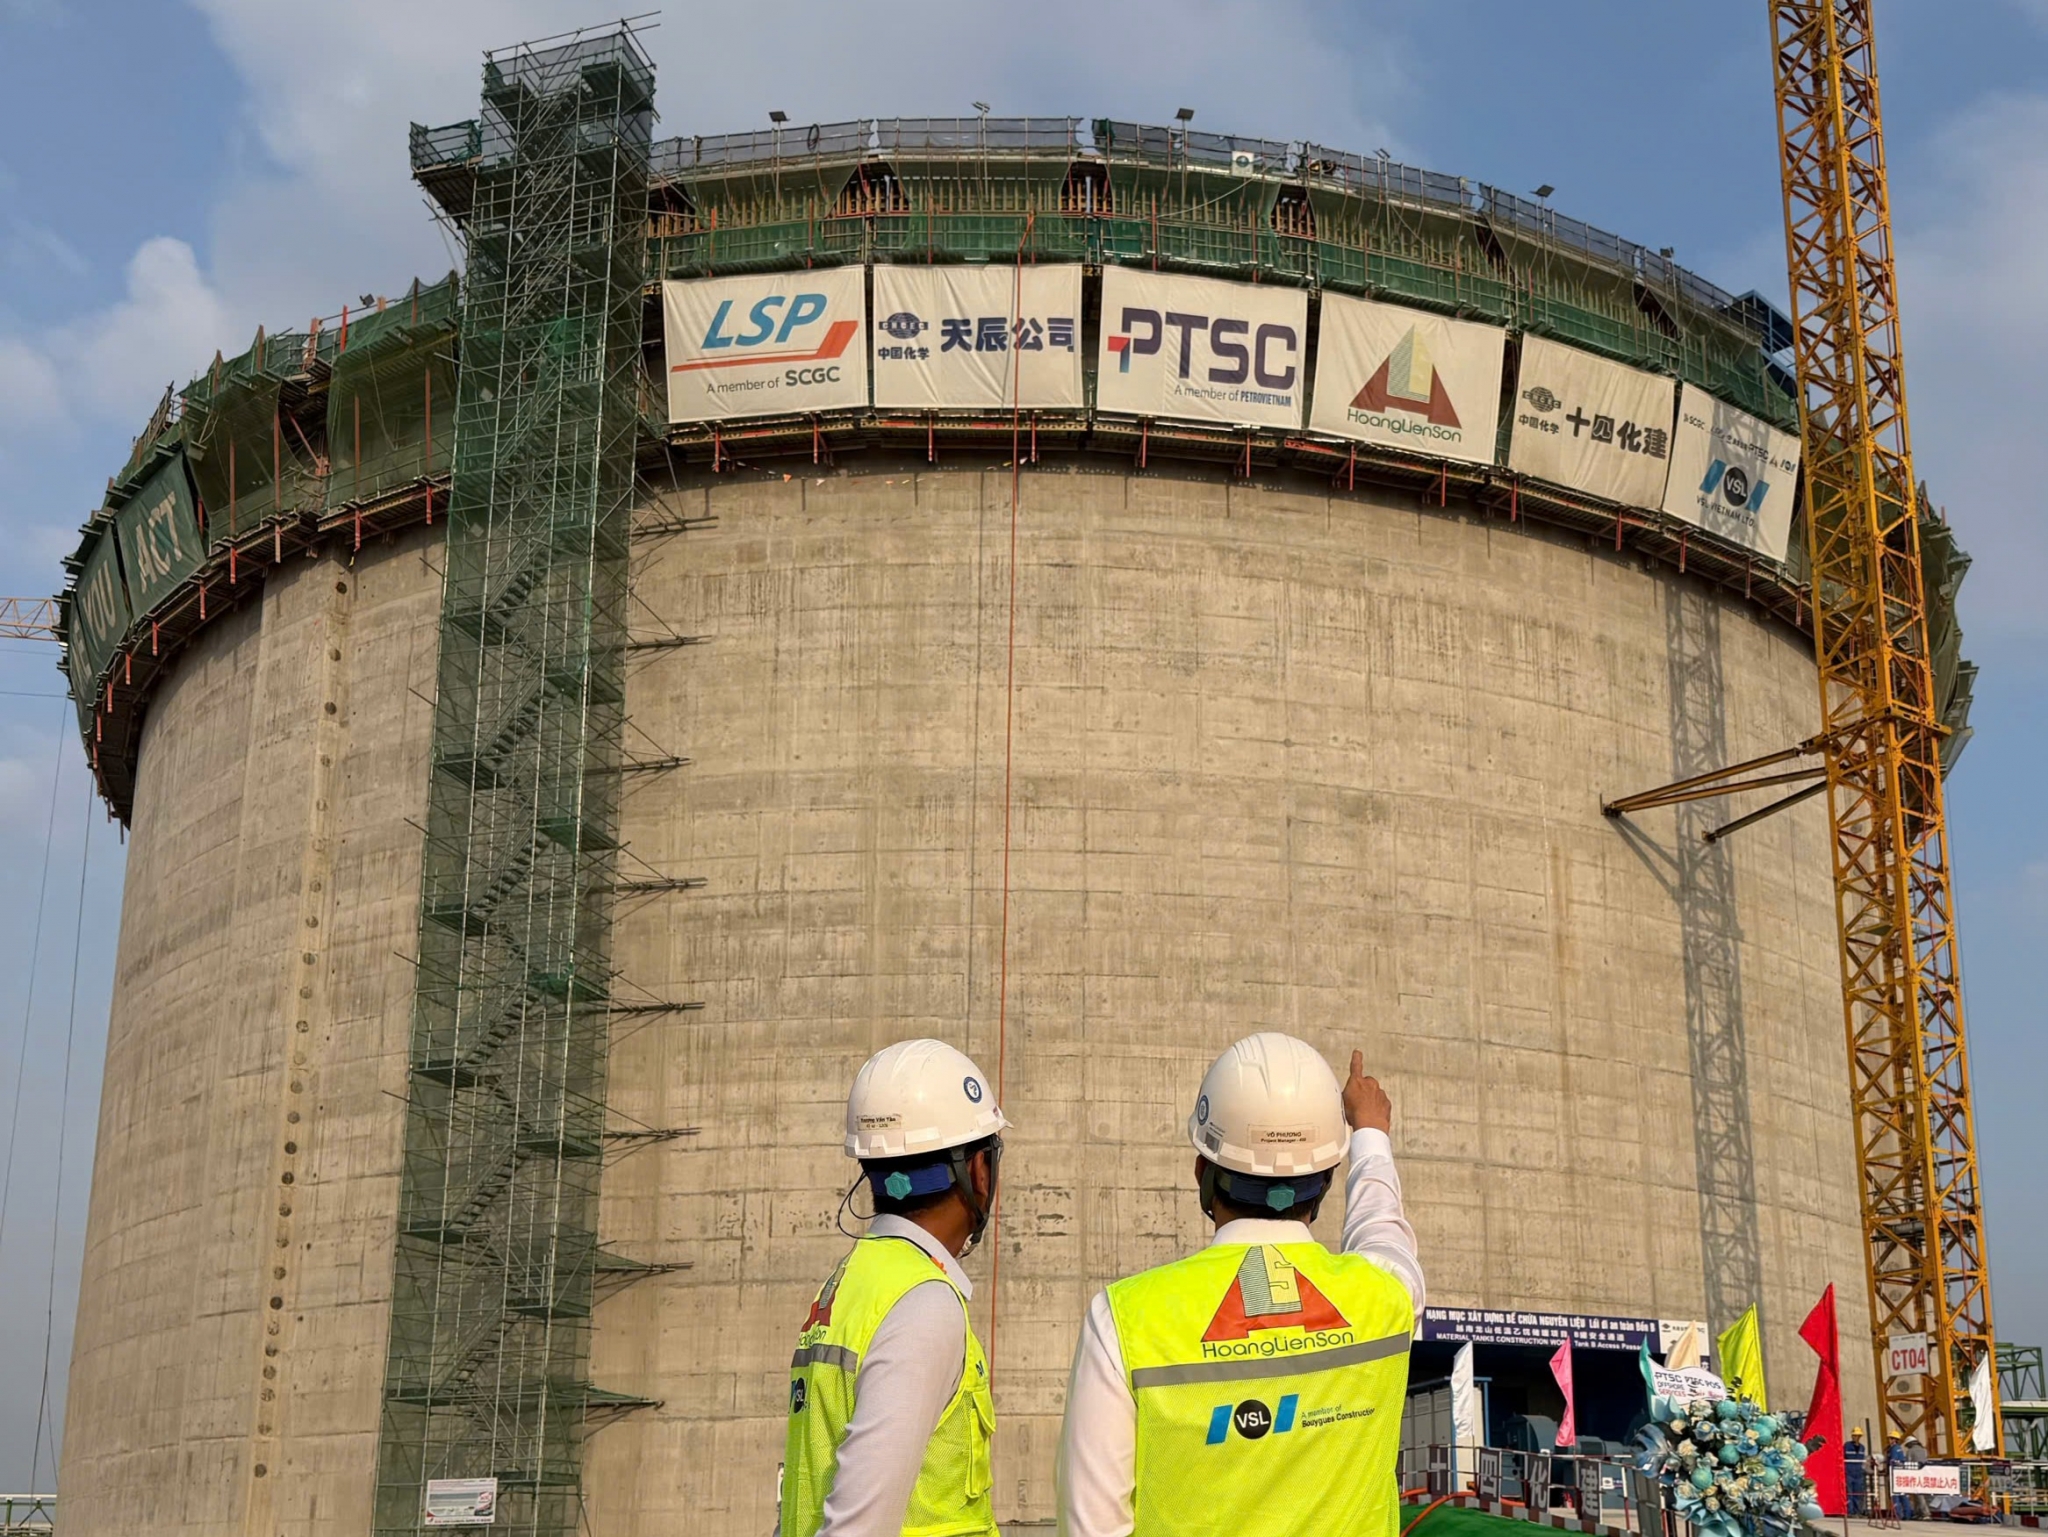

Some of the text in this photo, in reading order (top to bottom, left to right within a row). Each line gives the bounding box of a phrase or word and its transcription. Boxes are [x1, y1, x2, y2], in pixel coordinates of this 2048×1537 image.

[701, 294, 828, 349] LSP
[941, 317, 1074, 353] 天辰公司
[1108, 307, 1297, 390] PTSC
[706, 366, 840, 394] A member of SCGC
[1174, 385, 1291, 407] A member of PETROVIETNAM
[1347, 408, 1462, 442] HoangLienSon
[1565, 406, 1668, 460] 十四化建
[1726, 475, 1747, 497] VSL
[1711, 502, 1741, 521] VIETNAM
[82, 490, 184, 651] YOU ACT
[1436, 1333, 1469, 1341] MATERIAL
[1471, 1335, 1495, 1343] TANKS
[1496, 1336, 1549, 1345] CONSTRUCTION
[1650, 1322, 1656, 1332] B
[1202, 1331, 1354, 1358] HoangLienSon
[1892, 1347, 1926, 1371] CT04
[1236, 1410, 1270, 1429] VSL
[1302, 1417, 1335, 1428] Bouygues
[1528, 1461, 1548, 1508] 化
